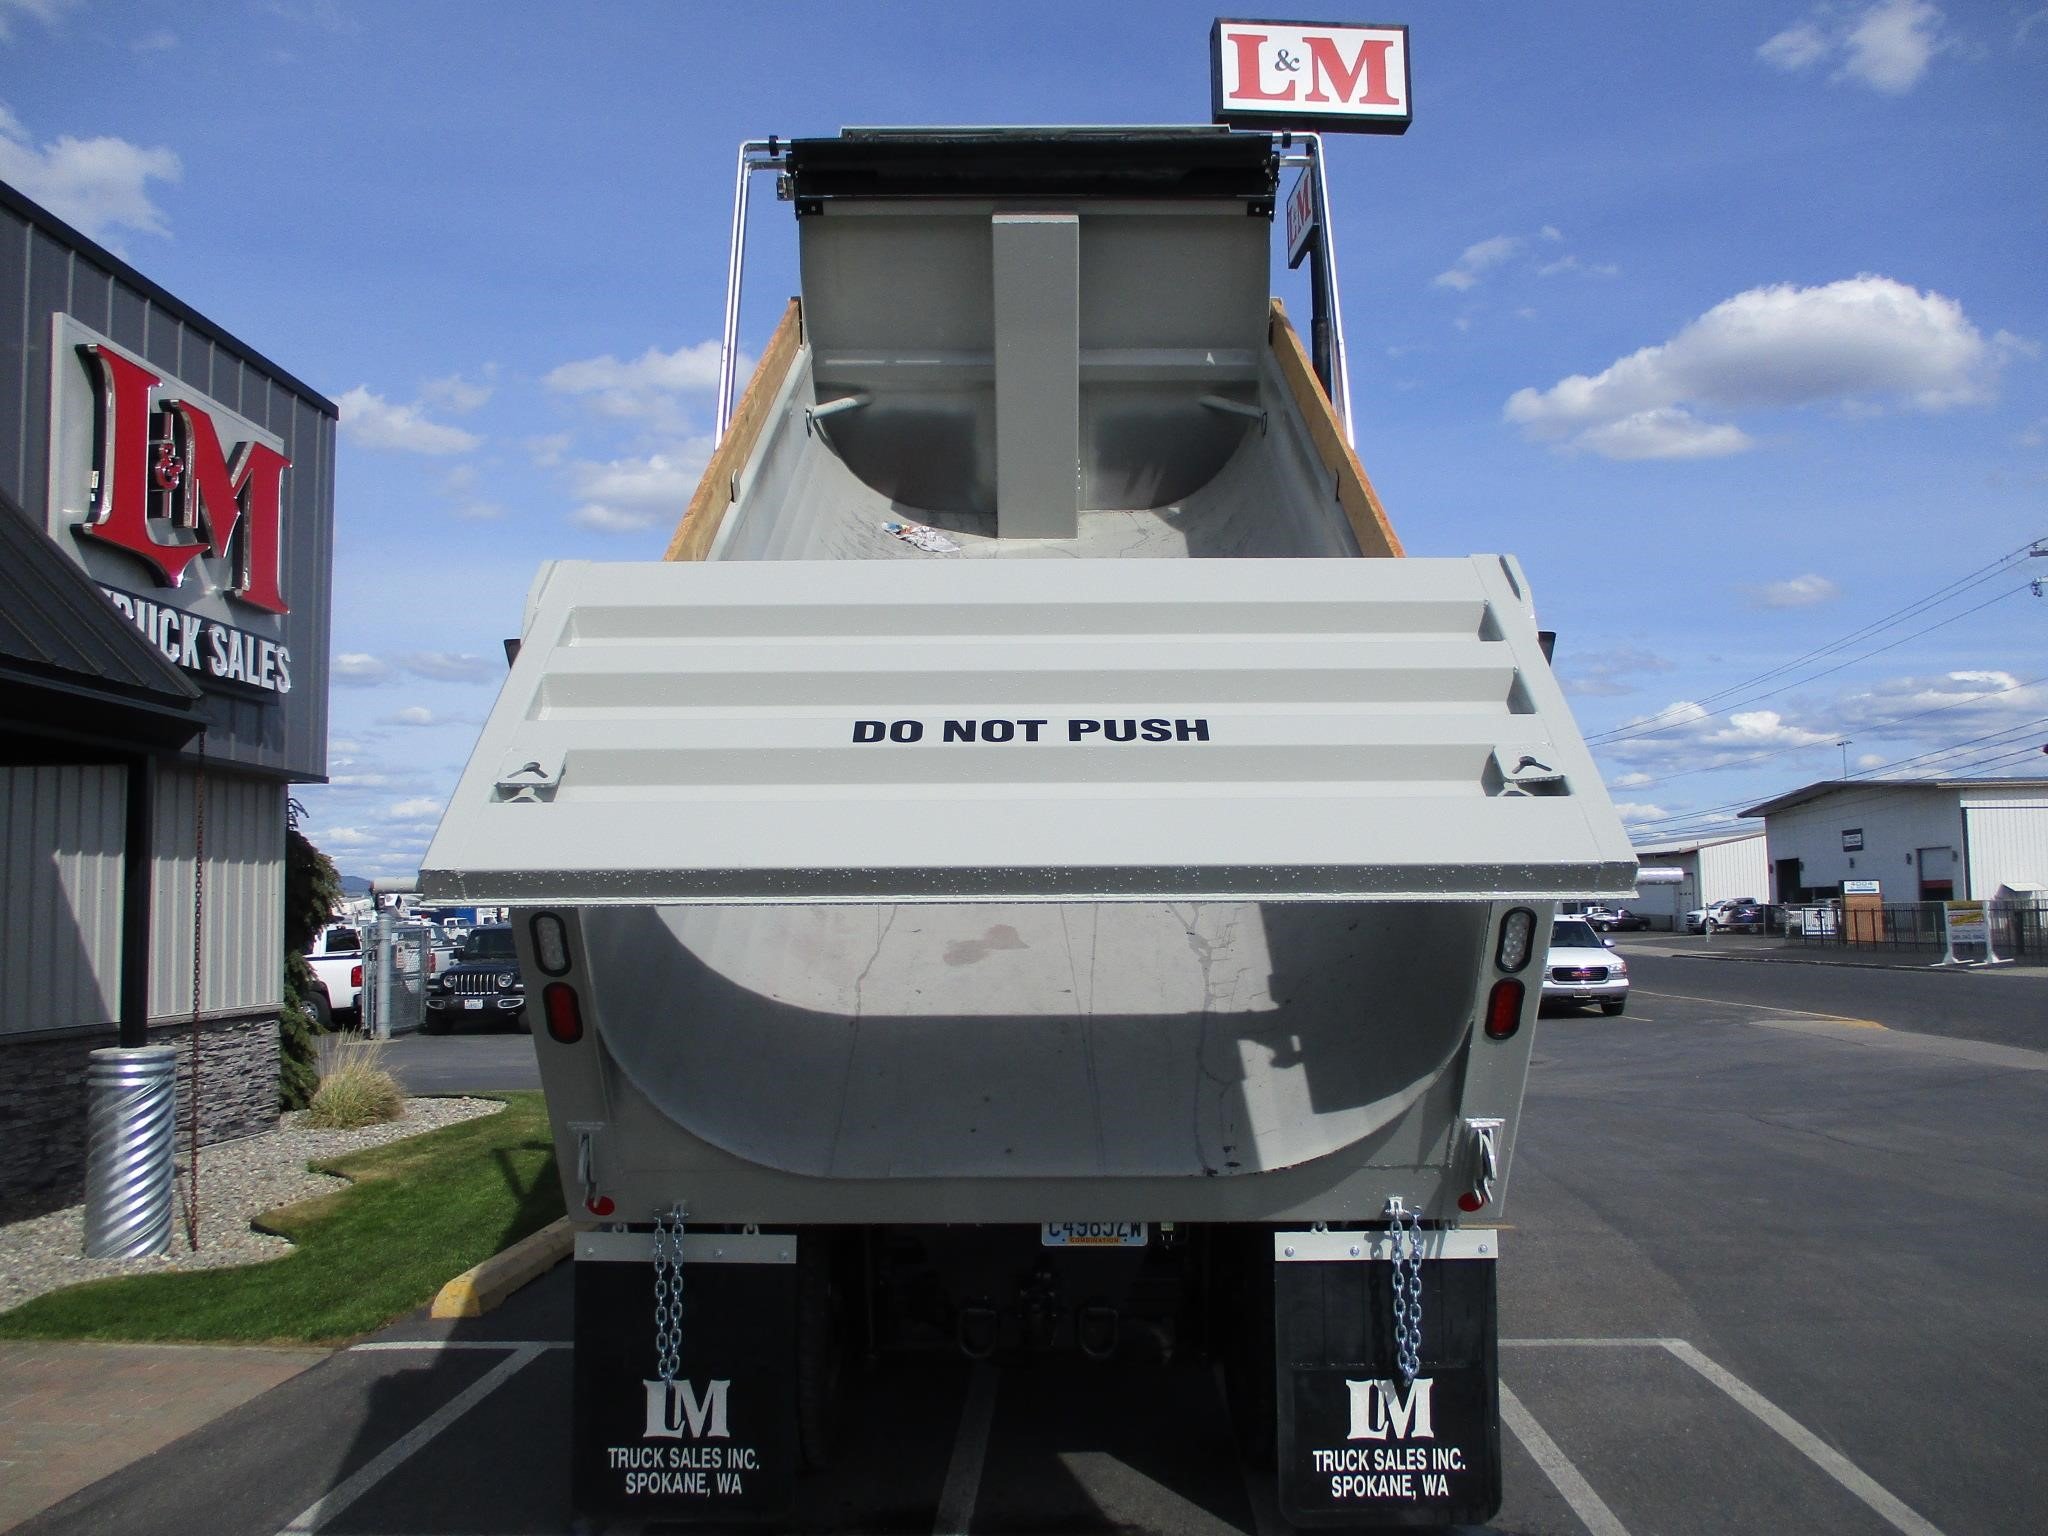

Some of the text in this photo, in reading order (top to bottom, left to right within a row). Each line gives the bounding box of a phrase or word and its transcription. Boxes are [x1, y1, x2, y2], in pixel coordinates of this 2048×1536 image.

[1227, 33, 1400, 106] L&M
[72, 343, 293, 615] L&M
[207, 623, 292, 694] SALES
[852, 718, 1210, 743] DO NOT PUSH
[607, 1448, 760, 1470] TRUCK SALES INC.
[1313, 1448, 1466, 1472] TRUCK SALES INC.
[625, 1472, 742, 1498] SPOKANE, WA
[1331, 1474, 1449, 1500] SPOKANE, WA
